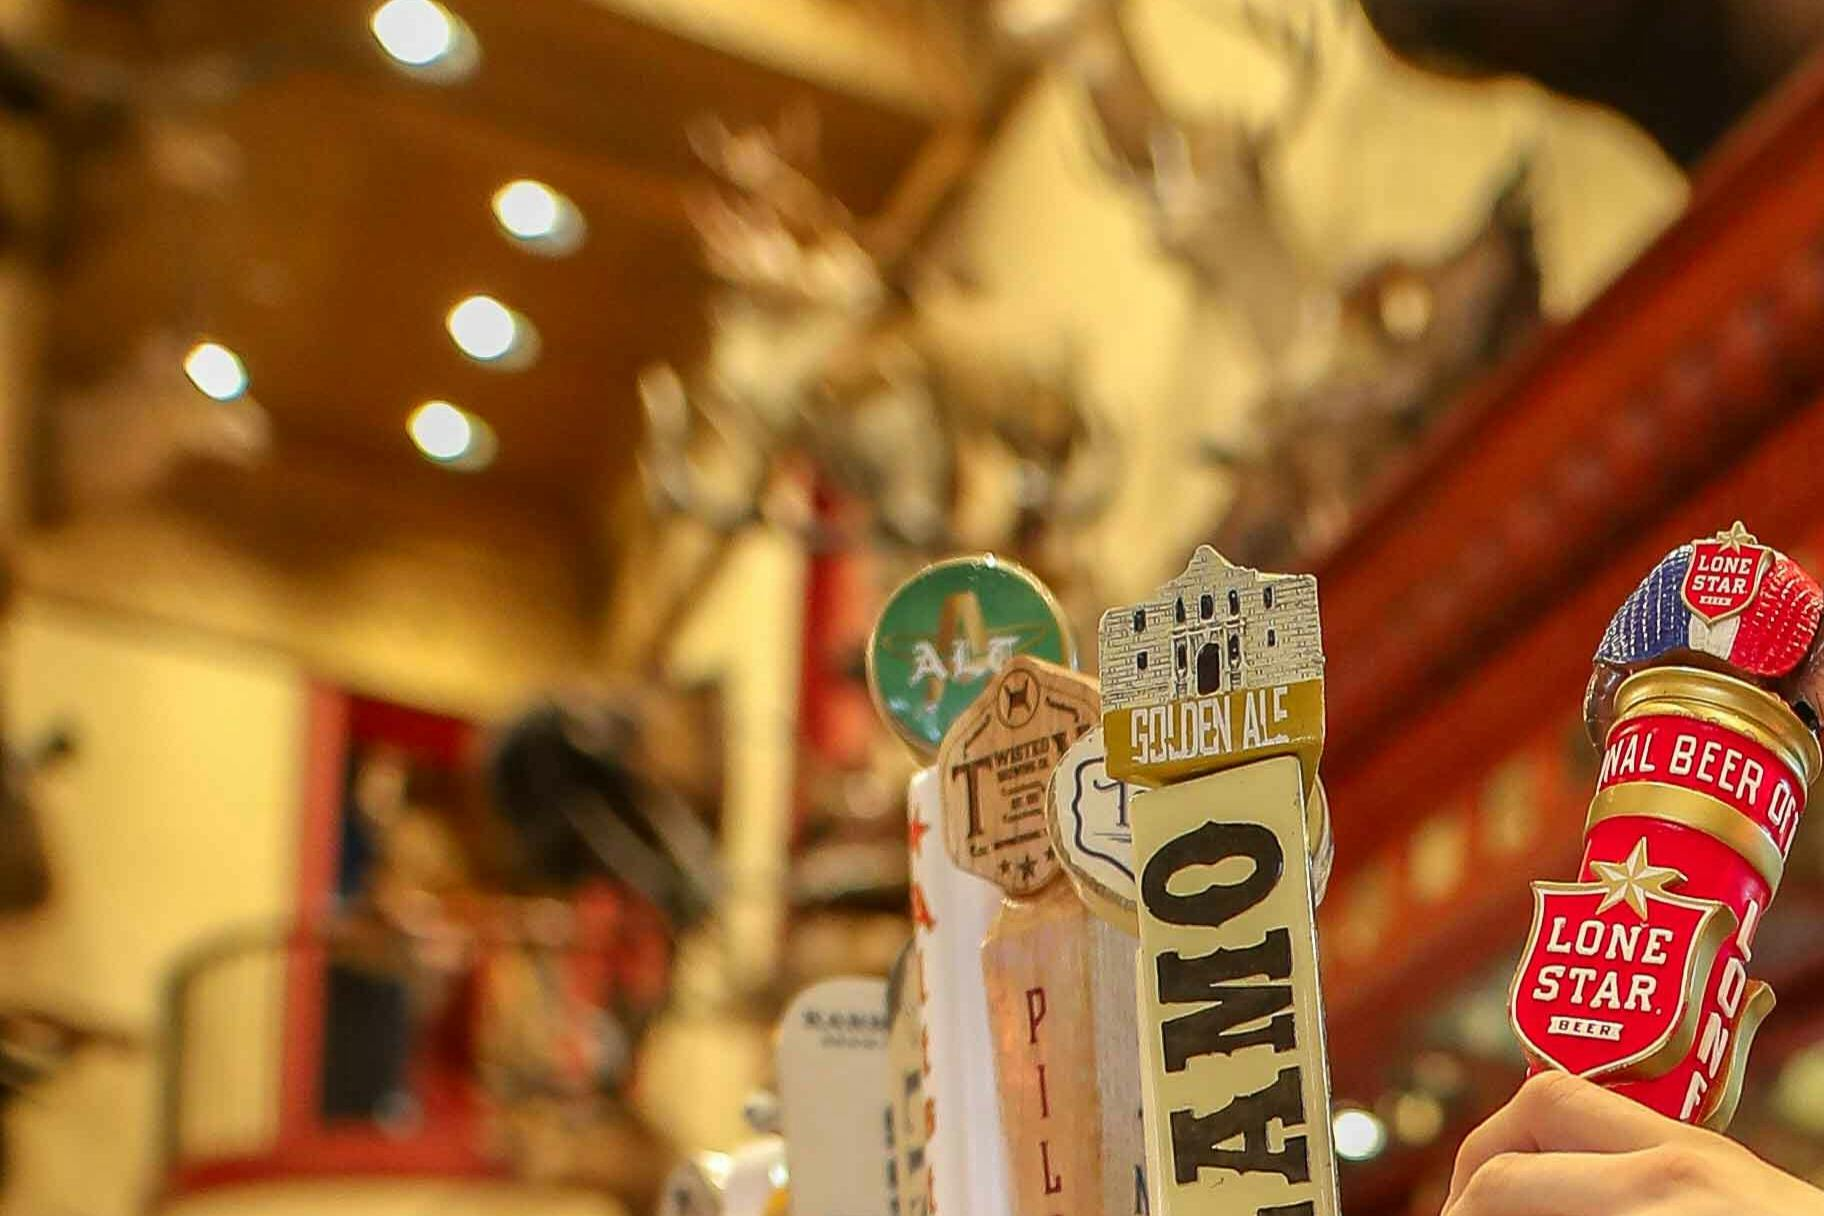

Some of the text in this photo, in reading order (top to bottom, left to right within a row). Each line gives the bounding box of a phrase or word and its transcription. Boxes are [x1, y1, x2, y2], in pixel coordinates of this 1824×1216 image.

[1697, 554, 1753, 575] LONE
[1131, 694, 1233, 765] GOLDEN
[1242, 686, 1291, 751] ALE
[1668, 734, 1764, 805] BEER
[1546, 916, 1674, 965] LONE
[1558, 1019, 1611, 1036] BEER
